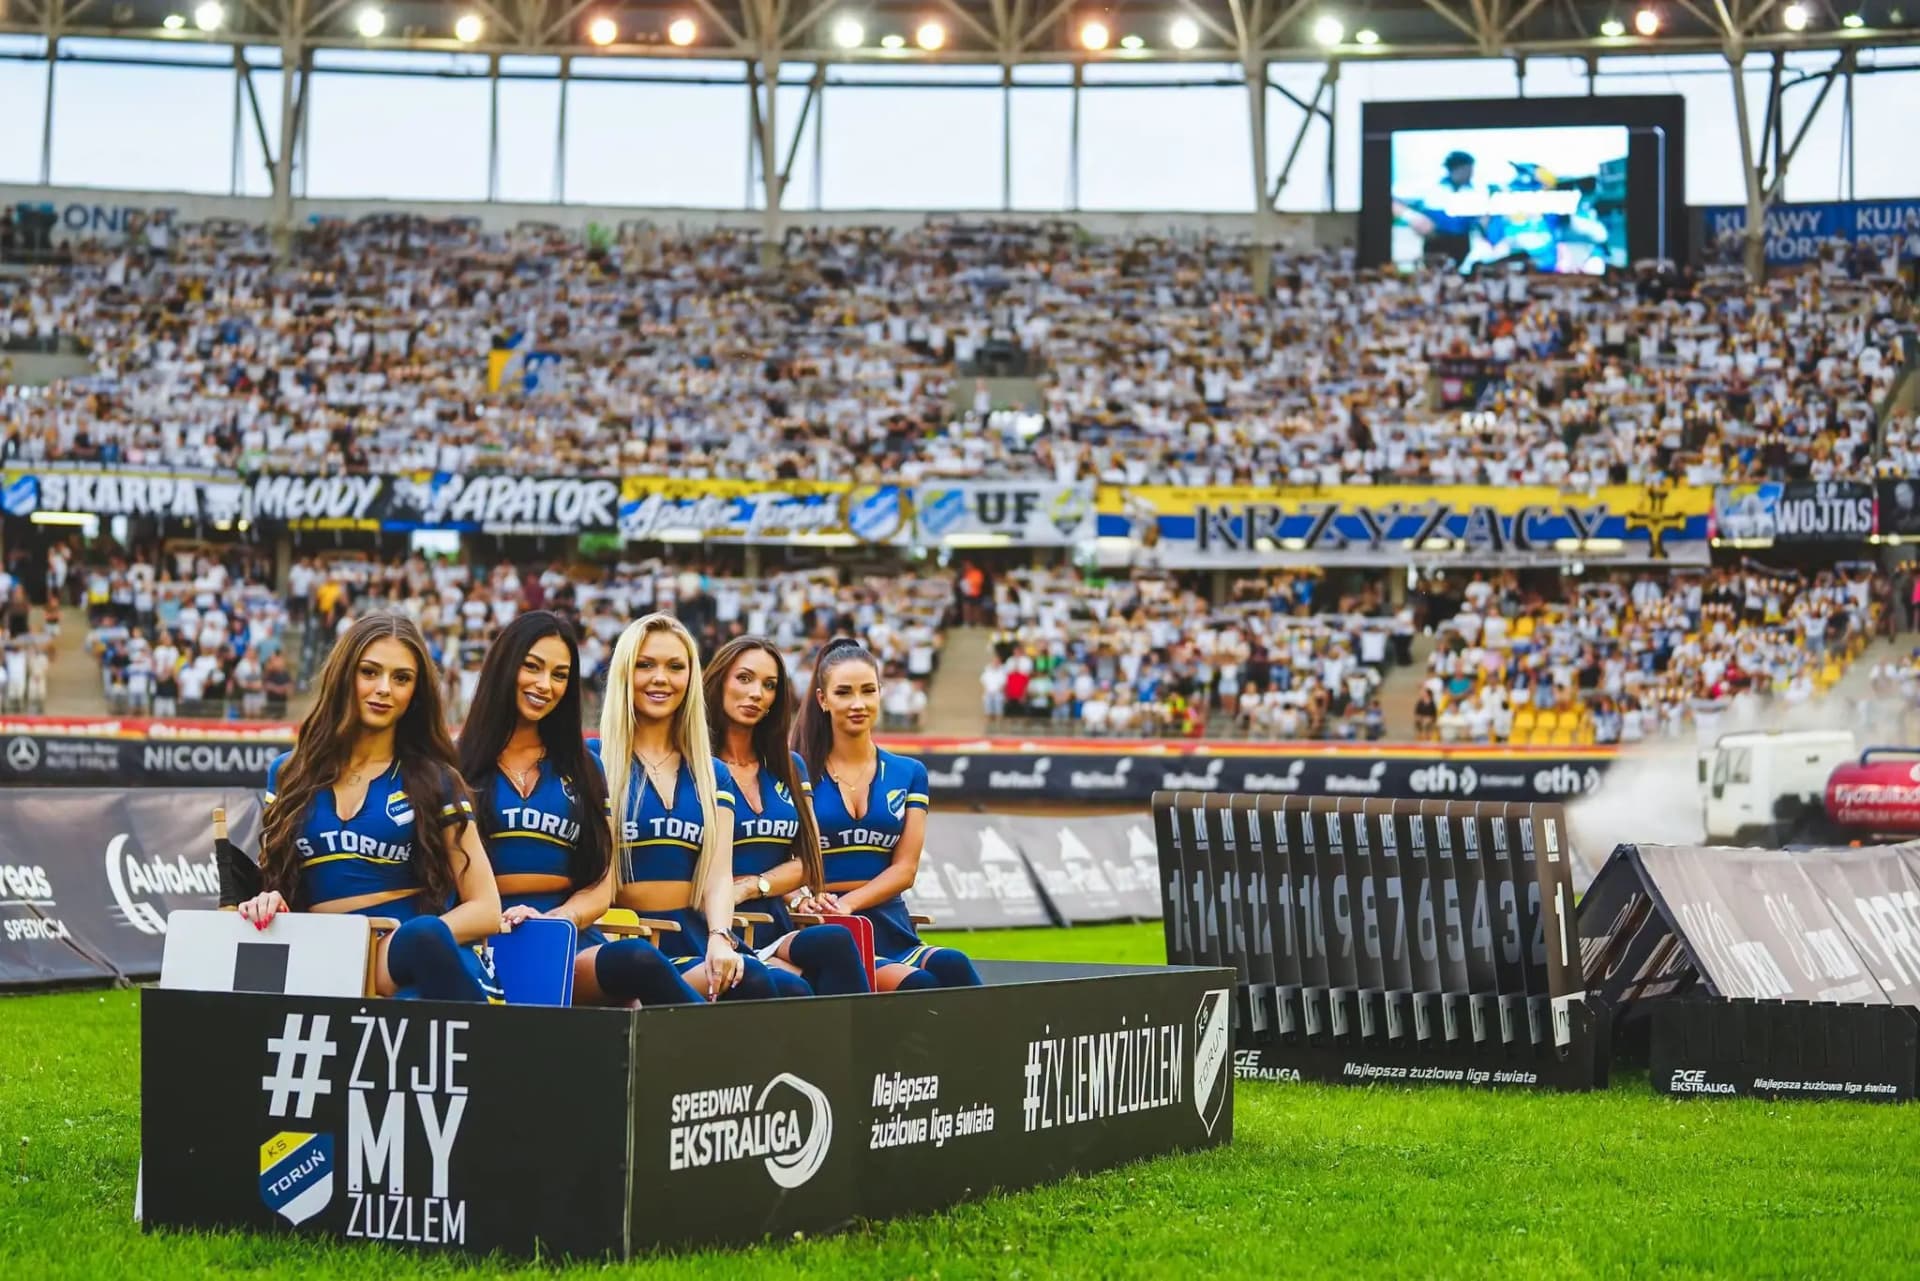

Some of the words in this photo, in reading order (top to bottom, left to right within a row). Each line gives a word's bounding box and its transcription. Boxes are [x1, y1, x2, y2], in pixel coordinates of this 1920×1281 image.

[40, 474, 200, 516] SKARPA
[450, 474, 619, 526] APATOR
[974, 491, 1040, 525] UF
[1193, 498, 1610, 551] KRZYŻACY
[1775, 498, 1872, 534] WOJTAS
[1409, 763, 1457, 793] eth
[1534, 763, 1580, 794] eth
[295, 837, 315, 857] S
[623, 820, 639, 841] S
[741, 818, 799, 838] TORU
[838, 828, 901, 848] TORU
[126, 852, 220, 895] AutoAnd
[1471, 879, 1493, 962] 4
[1499, 880, 1521, 964] 3
[1528, 881, 1548, 966] 2
[1555, 881, 1568, 967] 1
[348, 1007, 470, 1095] ŻYJE
[1234, 1050, 1262, 1066] GE
[872, 1071, 939, 1113] Najlepsza
[1234, 1066, 1300, 1082] STRALIGA
[1343, 1062, 1407, 1079] Najlepsza
[1409, 1064, 1464, 1080] żużlowa
[1466, 1067, 1490, 1084] liga
[1493, 1069, 1538, 1084] świata
[1671, 1082, 1736, 1094] EKSTRALIGA
[1753, 1078, 1801, 1091] Najlepsza
[1844, 1080, 1862, 1094] liga
[1863, 1081, 1897, 1094] świata
[671, 1084, 753, 1123] SPEEDWAY
[347, 1089, 468, 1198] MY
[670, 1109, 801, 1171] EKSTRALIGA
[870, 1112, 927, 1150] żużlowa
[930, 1107, 952, 1148] liga
[955, 1102, 995, 1137] świata
[267, 1140, 288, 1158] KS
[267, 1148, 326, 1196] TORUŃ
